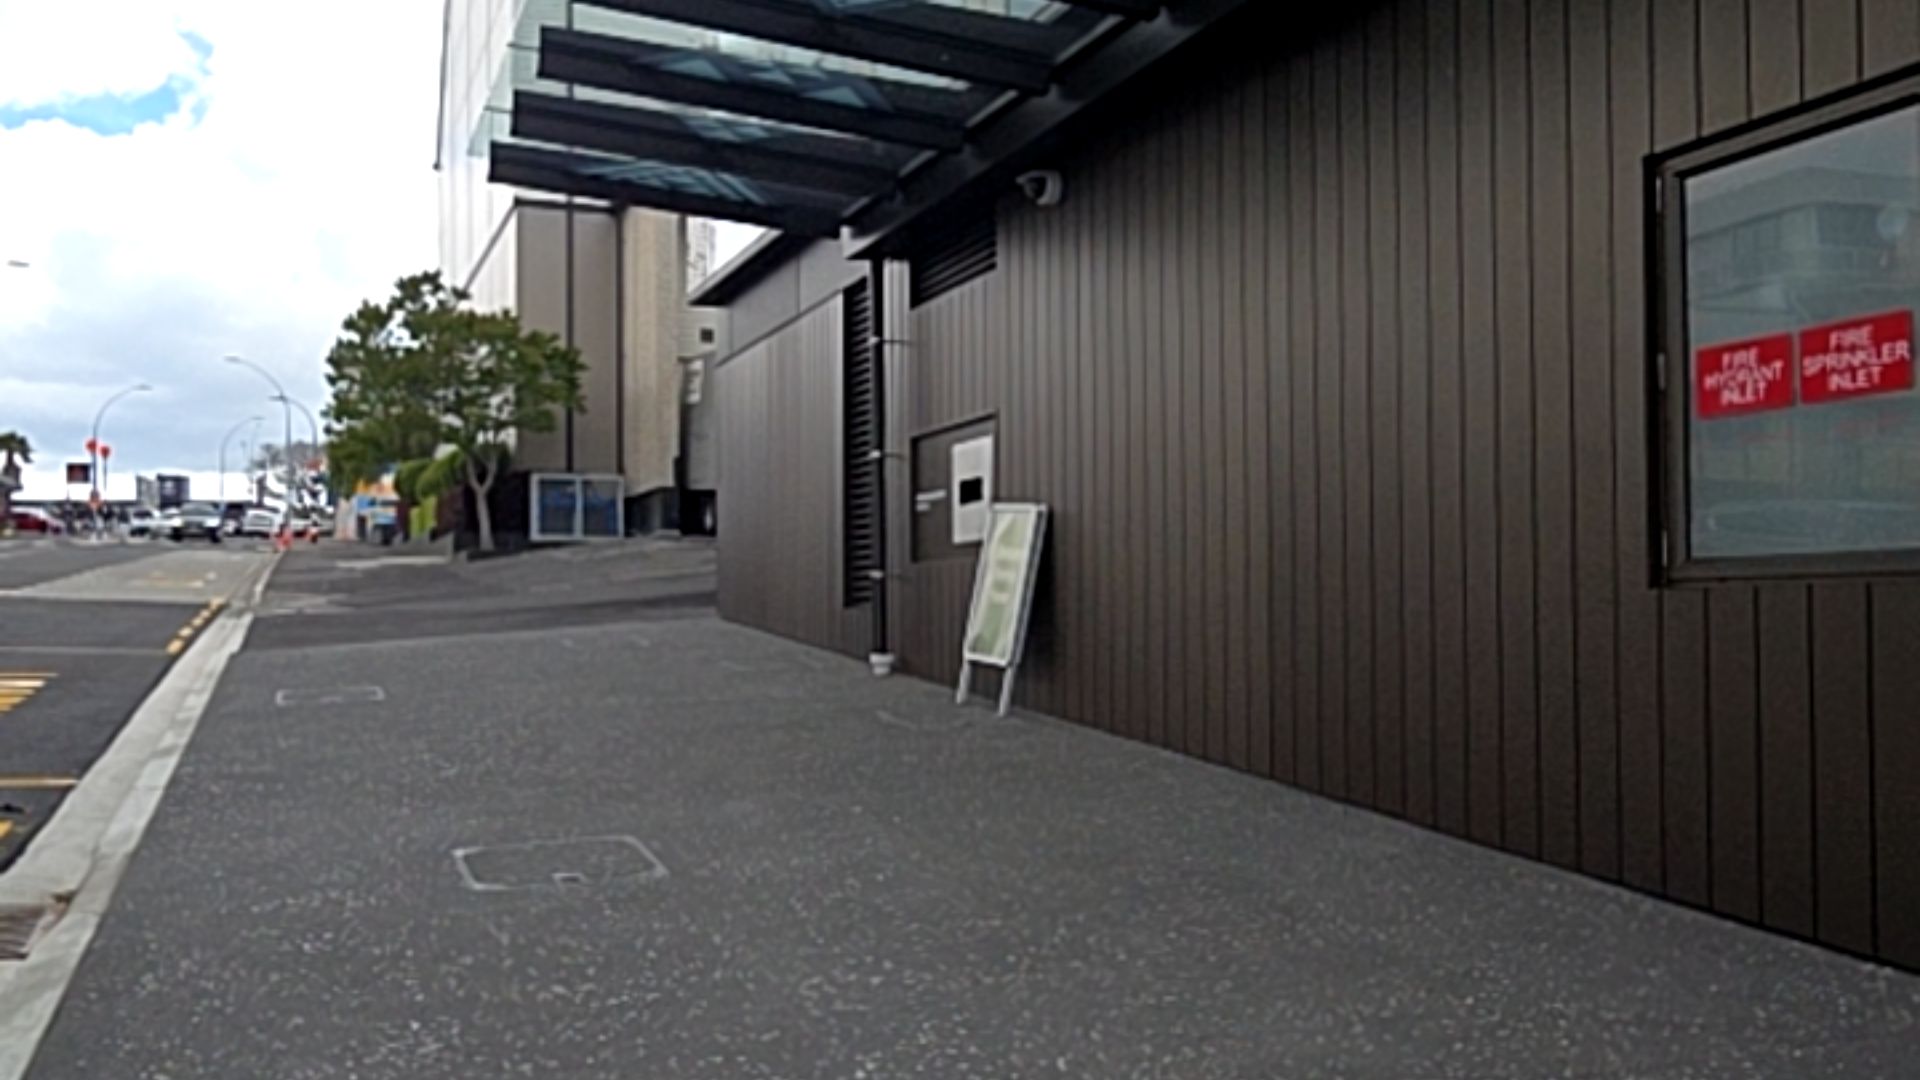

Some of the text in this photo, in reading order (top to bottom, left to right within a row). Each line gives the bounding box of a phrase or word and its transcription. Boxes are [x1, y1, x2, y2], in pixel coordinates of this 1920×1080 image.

[1829, 324, 1873, 348] FIRE
[1722, 348, 1759, 368] FIRE
[1802, 340, 1910, 376] SPRINKLER
[1828, 366, 1884, 391] INLET
[1721, 381, 1767, 406] INLET
